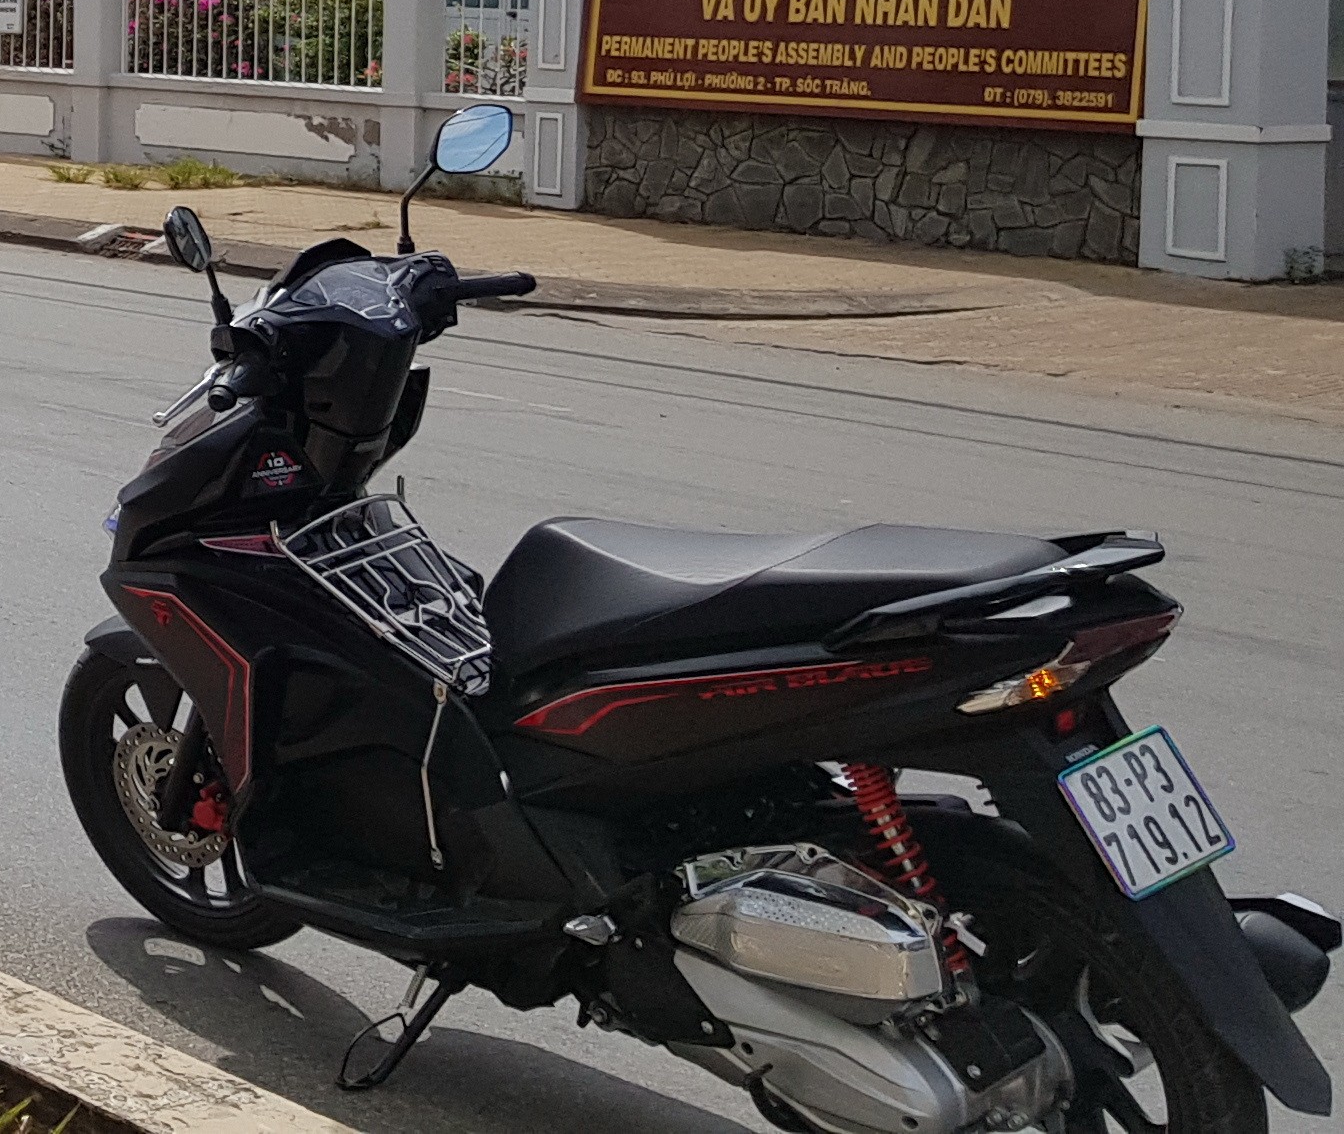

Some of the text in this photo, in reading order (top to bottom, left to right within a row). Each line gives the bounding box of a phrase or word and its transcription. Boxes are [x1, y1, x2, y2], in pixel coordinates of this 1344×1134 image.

[601, 35, 1128, 79] PERMANENT PEOPLE'S ASSEMBLY AND PEOPLE'S COMMITTEES
[650, 68, 674, 85] PHÚ
[676, 71, 696, 90] LỢI
[704, 70, 755, 91] PHƯỜNG
[756, 76, 766, 91] 2
[773, 76, 793, 92] TP.
[796, 74, 822, 94] SÓC
[1054, 90, 1115, 109] 3822591
[266, 456, 285, 468] 10
[1080, 743, 1175, 823] 83-P3
[1103, 794, 1222, 887] 719.12
